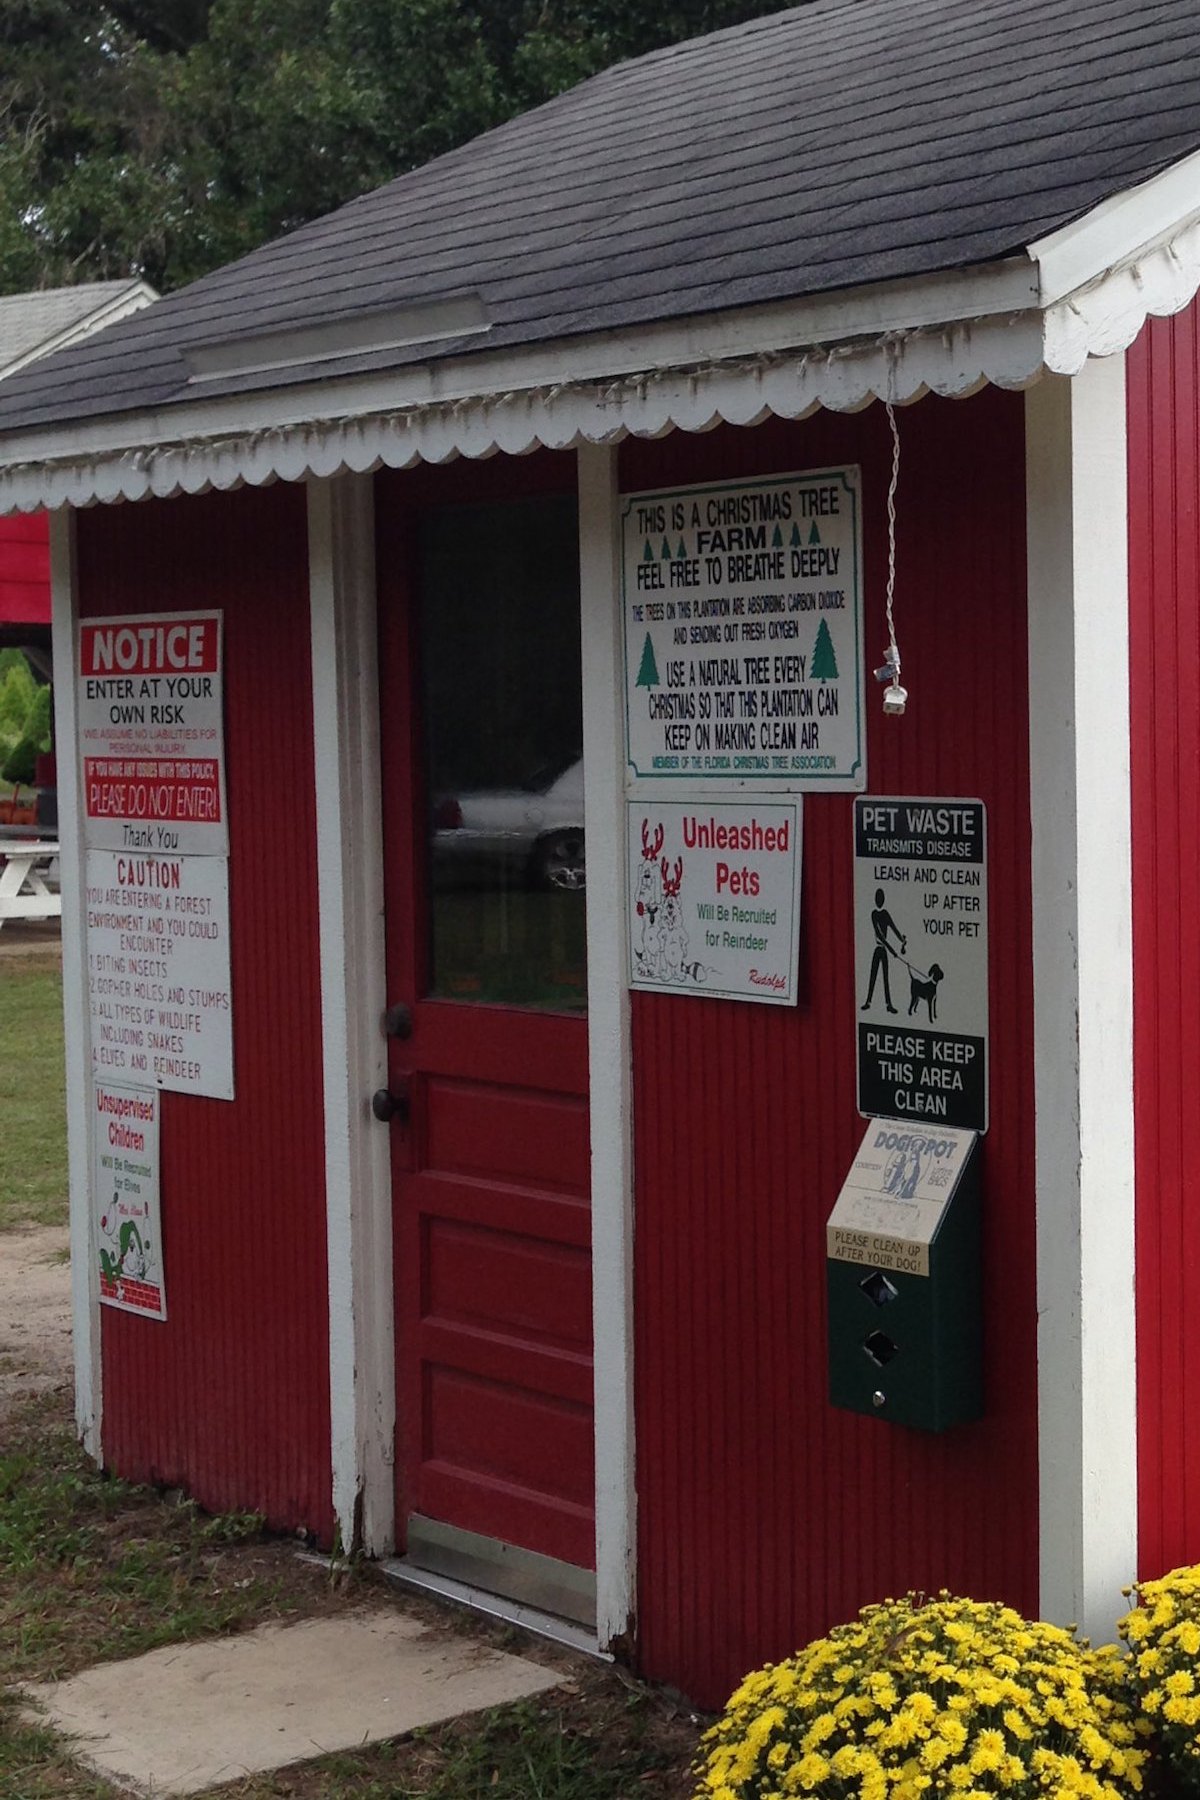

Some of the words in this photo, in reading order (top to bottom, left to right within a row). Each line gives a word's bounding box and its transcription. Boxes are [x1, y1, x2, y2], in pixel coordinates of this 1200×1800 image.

[637, 505, 666, 534] THIS
[672, 503, 685, 531] IS
[691, 502, 701, 528] A
[707, 491, 792, 527] CHRISTMAS
[798, 486, 840, 517] TREE
[697, 525, 766, 554] FARM
[637, 563, 665, 590] FEEL
[670, 559, 700, 588] FREE
[705, 556, 722, 585] TO
[728, 552, 785, 583] BREATHE
[791, 547, 840, 578] DEEPLY
[645, 602, 664, 621] TREES
[666, 602, 676, 620] ON
[677, 601, 691, 619] THIS
[693, 597, 730, 618] PLANTATION
[733, 597, 745, 615] ARE
[747, 594, 785, 615] ABSORBING
[787, 592, 816, 612] CARBON
[673, 627, 688, 645] AND
[690, 624, 721, 644] SENDING
[724, 623, 739, 642] OUT
[742, 622, 766, 641] FRESH
[768, 620, 799, 640] OXYGEN
[92, 625, 205, 671] NOTICE
[666, 660, 685, 688] USE
[689, 660, 696, 687] A
[699, 658, 742, 686] NATURAL
[744, 656, 770, 684] TREE
[774, 655, 806, 683] EVERY
[87, 679, 135, 699] ENTER
[139, 679, 161, 698] AT
[166, 677, 213, 698] YOUR
[110, 705, 145, 724] OWN
[151, 705, 185, 724] RISK
[648, 691, 696, 720] CHRISTMAS
[699, 691, 711, 719] SO
[714, 691, 735, 718] THAT
[738, 690, 757, 718] THIS
[761, 688, 813, 717] PLANTATION
[817, 687, 839, 717] CAN
[109, 743, 152, 753] PERSONAL
[200, 729, 217, 740] FOR
[665, 724, 691, 750] KEEP
[695, 723, 710, 750] ON
[715, 722, 756, 750] MAKING
[760, 722, 796, 750] CLEAN
[801, 722, 819, 749] AIR
[681, 756, 690, 769] OF
[704, 756, 731, 769] FLORIDA
[733, 756, 769, 769] CHRISTMAS
[771, 756, 789, 768] TREE
[791, 755, 836, 769] ASSOCIATION
[90, 784, 126, 814] PLEASE
[128, 784, 146, 815] DO
[149, 785, 175, 816] NOT
[176, 786, 217, 818] ENTER!
[683, 817, 789, 852] Unleashed
[862, 807, 899, 832] PET
[906, 808, 975, 836] WASTE
[123, 825, 153, 847] Thank
[157, 827, 179, 849] You
[866, 838, 924, 855] TRANSMITS
[927, 840, 972, 857] DISEASE
[716, 862, 760, 896] Pets
[874, 865, 910, 882] LEASH
[914, 868, 937, 883] AND
[942, 869, 980, 886] CLEAN
[86, 887, 103, 904] YOU
[105, 888, 120, 906] ARE
[122, 889, 162, 910] ENTERING
[165, 896, 171, 910] A
[174, 896, 212, 915] FOREST
[697, 903, 714, 920] Will
[717, 905, 730, 921] Be
[732, 906, 777, 925] Recruited
[924, 893, 939, 908] UP
[943, 895, 980, 912] AFTER
[88, 911, 143, 931] ENVIRONMENT
[147, 917, 164, 935] AND
[167, 919, 185, 937] YOU
[188, 921, 219, 939] COULD
[923, 918, 954, 936] YOUR
[958, 922, 980, 938] PET
[121, 934, 173, 955] ENCOUNTER
[705, 930, 720, 947] for
[723, 931, 768, 952] Reindeer
[97, 954, 126, 973] BITING
[128, 959, 168, 978] INSECTS
[749, 968, 787, 991] Rudolph
[134, 982, 164, 1003] HOLES
[167, 987, 185, 1005] AND
[188, 989, 229, 1010] STUMPS
[99, 1003, 113, 1019] ALL
[115, 1004, 141, 1024] TYPES
[144, 1008, 155, 1025] OF
[158, 1010, 201, 1032] WILDLIFE
[101, 1024, 143, 1046] INCLUDING
[147, 1031, 184, 1053] SNAKES
[866, 1032, 926, 1059] PLEASE
[932, 1041, 975, 1064] KEEP
[100, 1046, 125, 1067] ELVES
[131, 1053, 147, 1071] AND
[153, 1056, 201, 1080] REINDEER
[878, 1060, 913, 1084] THIS
[920, 1066, 964, 1091] AREA
[97, 1088, 154, 1122] Unsupervised
[894, 1089, 947, 1116] CLEAN
[108, 1121, 144, 1152] Children
[114, 1157, 123, 1171] Be
[114, 1176, 123, 1190] for
[835, 1231, 869, 1248] PLEASE
[873, 1238, 903, 1254] CLEAN
[907, 1244, 921, 1256] UP
[835, 1245, 864, 1260] AFTER
[867, 1251, 893, 1267] YOUR
[896, 1257, 921, 1272] DOG!
